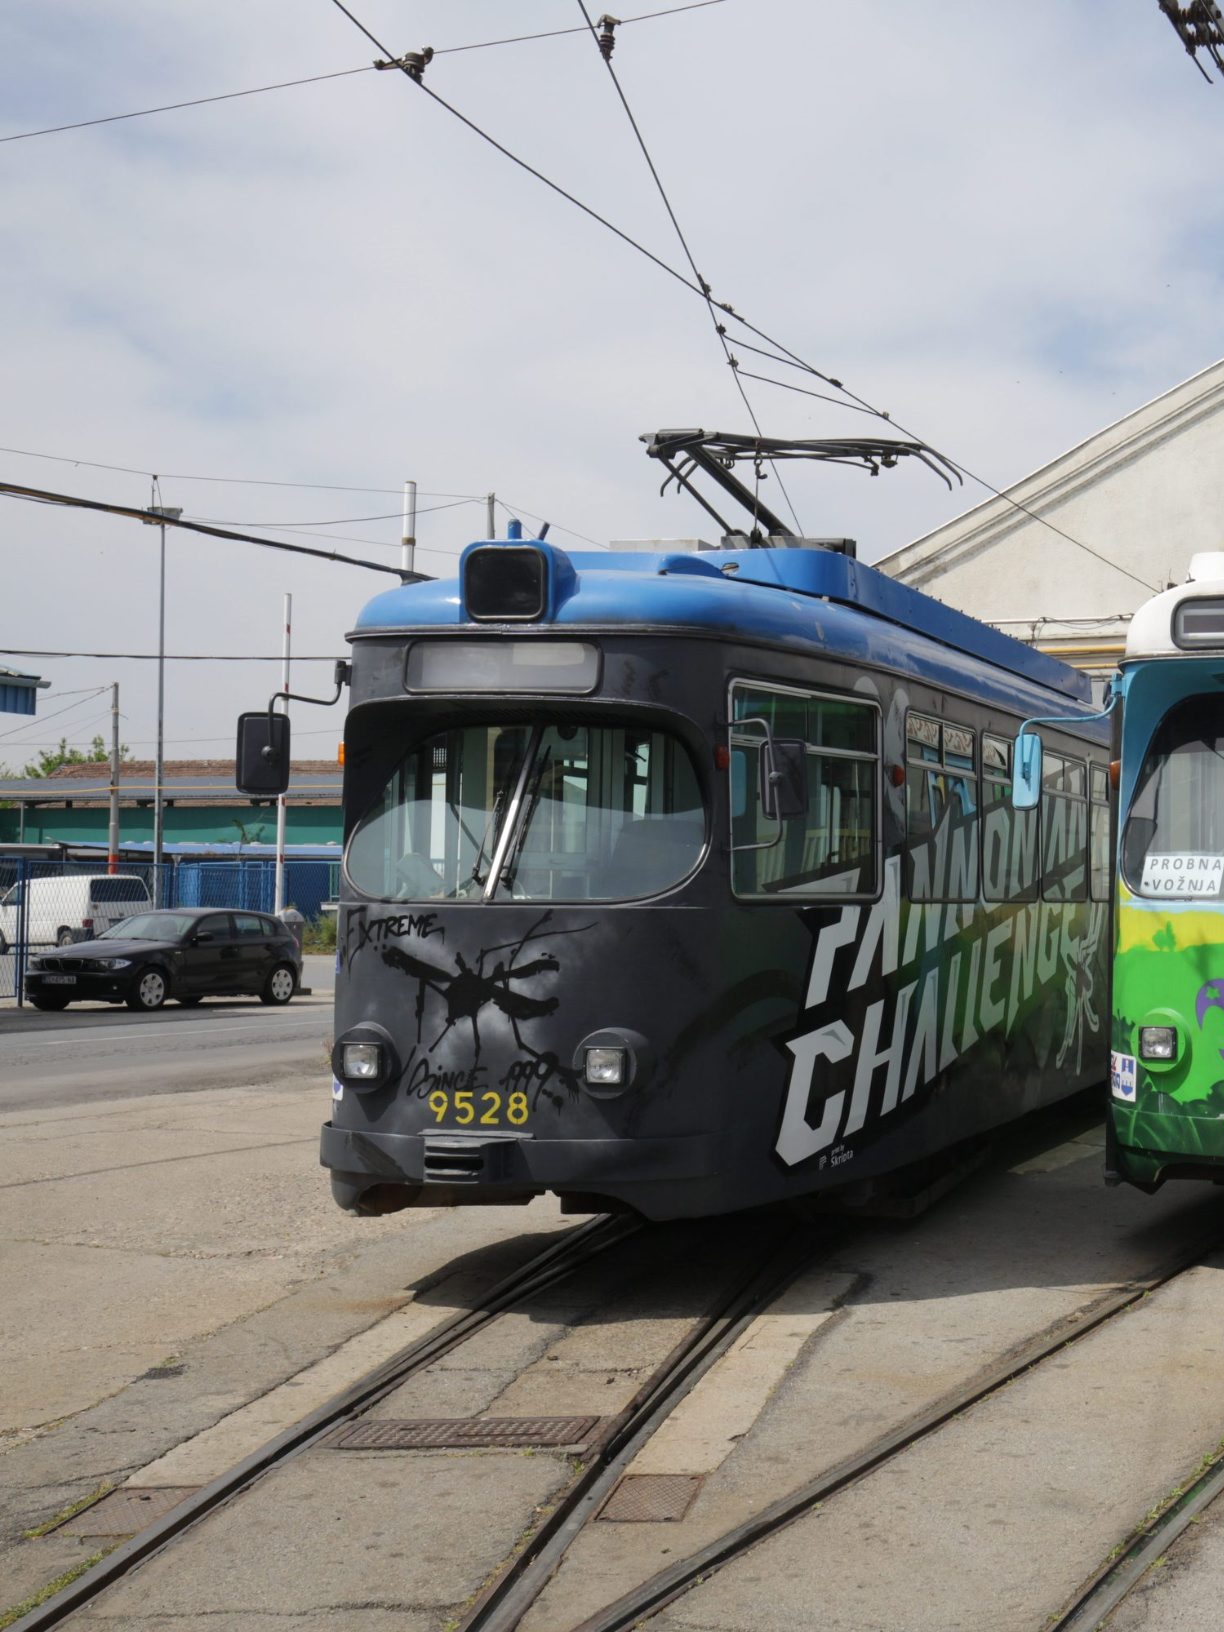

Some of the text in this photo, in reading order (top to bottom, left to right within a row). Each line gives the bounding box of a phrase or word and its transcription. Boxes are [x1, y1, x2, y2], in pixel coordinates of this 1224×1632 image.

[1149, 858, 1222, 871] PROBNA
[1152, 875, 1216, 891] VOŽNJA
[347, 906, 444, 962] EXTREME
[429, 1090, 529, 1125] 9528
